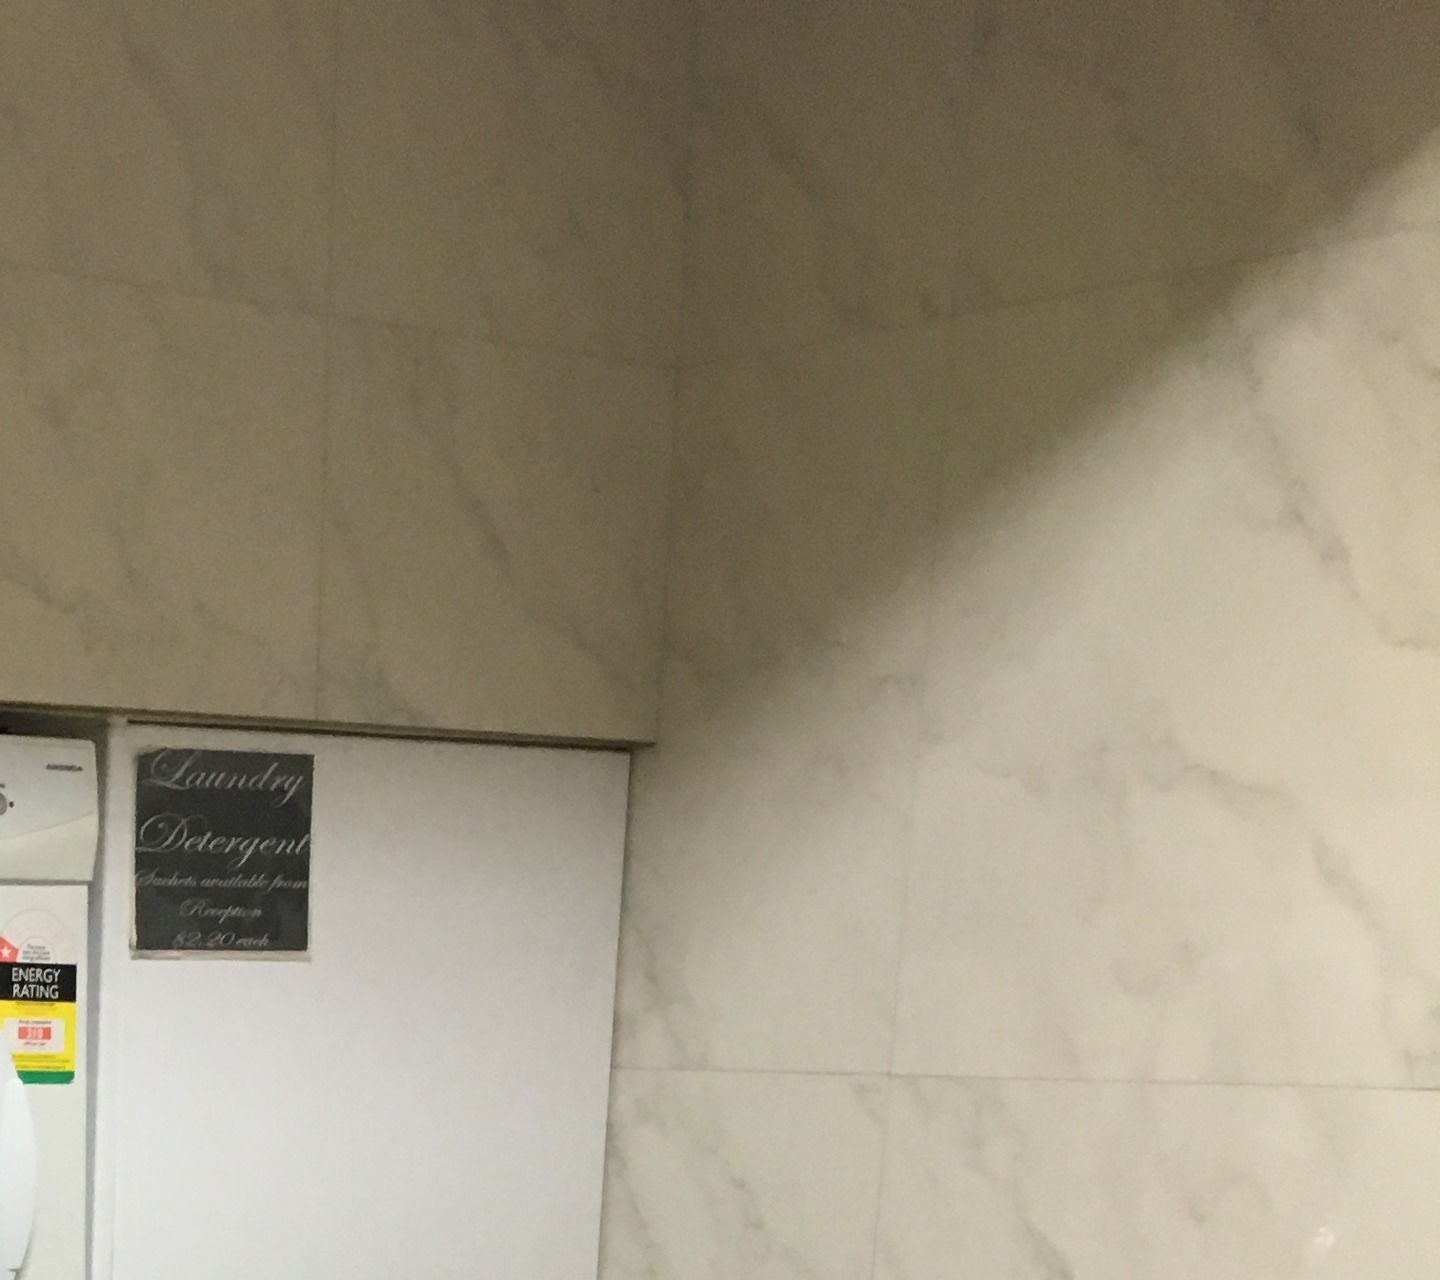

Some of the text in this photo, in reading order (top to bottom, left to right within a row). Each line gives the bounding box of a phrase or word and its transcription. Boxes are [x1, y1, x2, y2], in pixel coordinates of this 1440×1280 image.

[142, 750, 304, 808] Laundry
[135, 812, 310, 869] Detergent
[136, 868, 197, 888] Sachets
[264, 874, 308, 894] from
[179, 899, 262, 925] Reception
[11, 967, 61, 983] ENERGY
[12, 984, 60, 999] RATING
